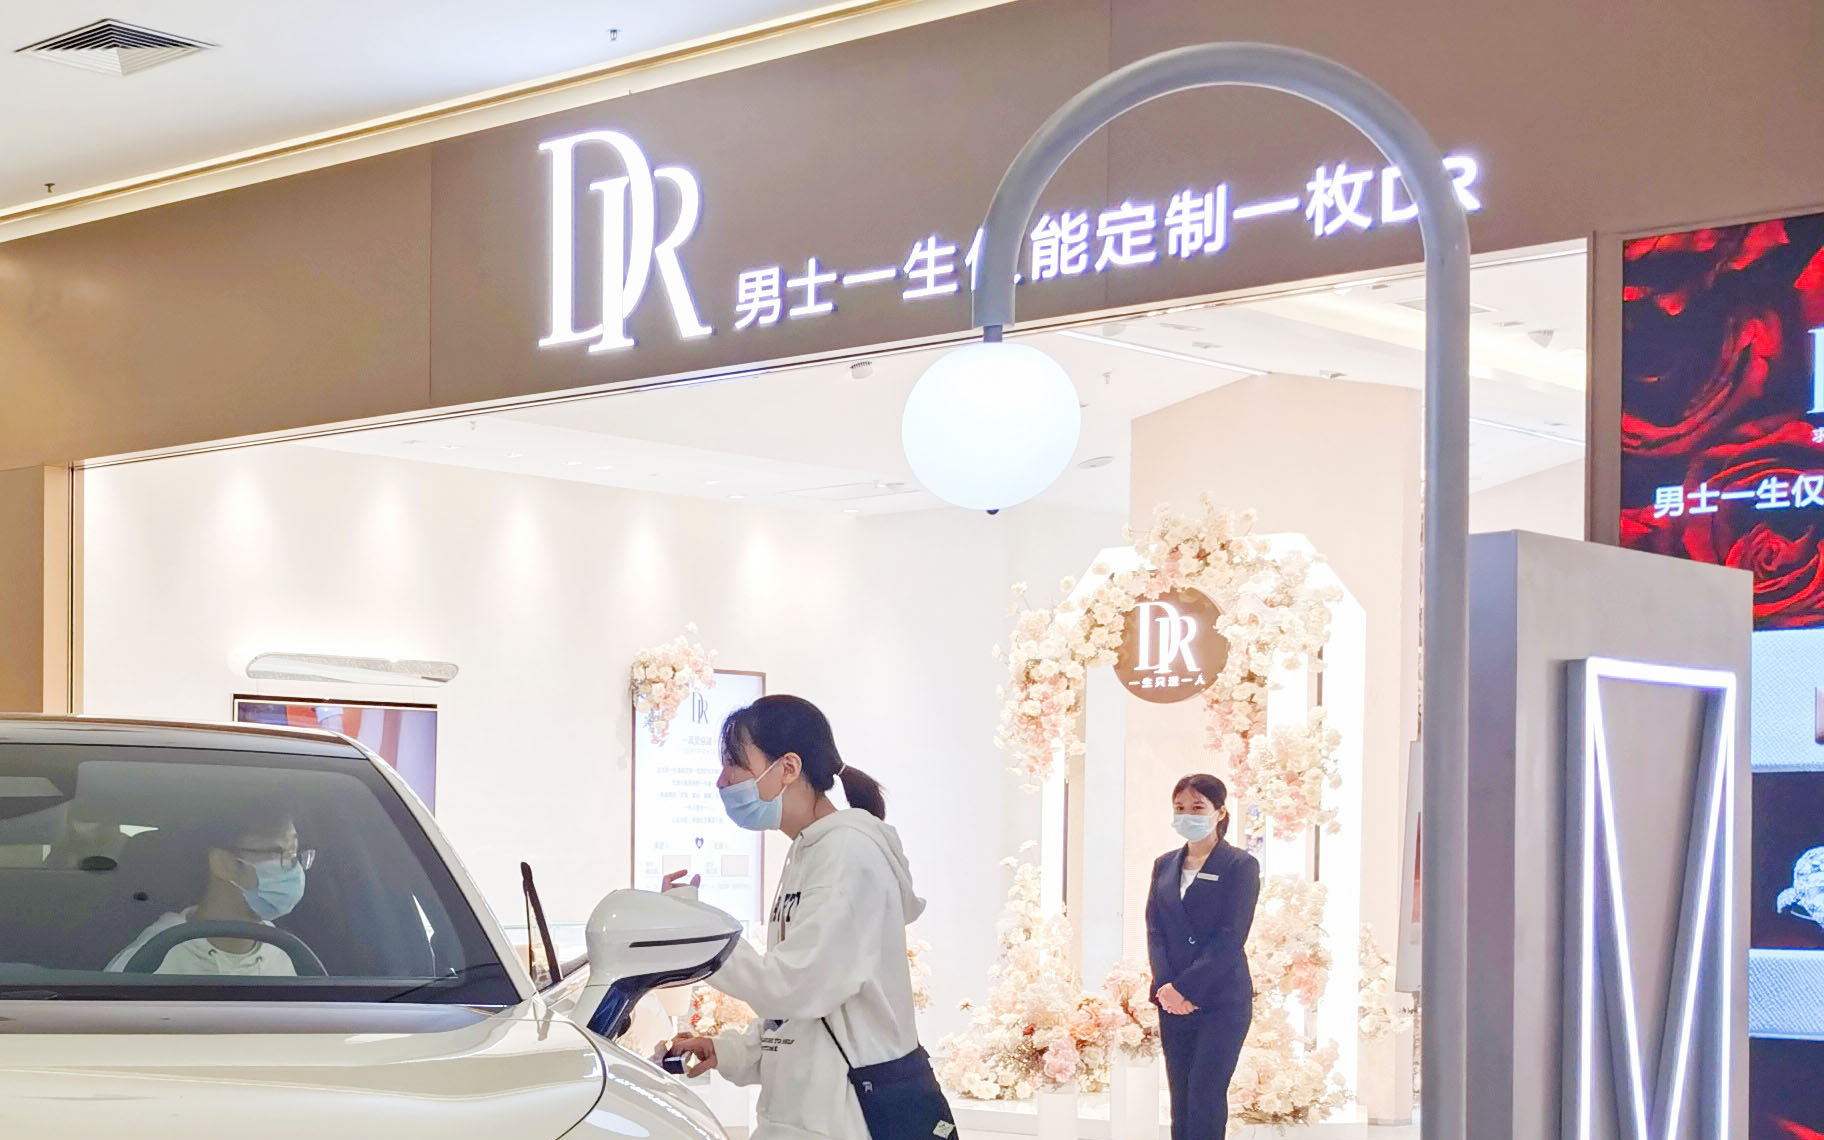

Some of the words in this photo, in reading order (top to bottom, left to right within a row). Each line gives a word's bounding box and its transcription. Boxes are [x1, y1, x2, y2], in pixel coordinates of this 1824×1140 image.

[537, 129, 714, 353] DR
[1653, 475, 1824, 519] 男士一生仅
[1134, 601, 1201, 674] DR
